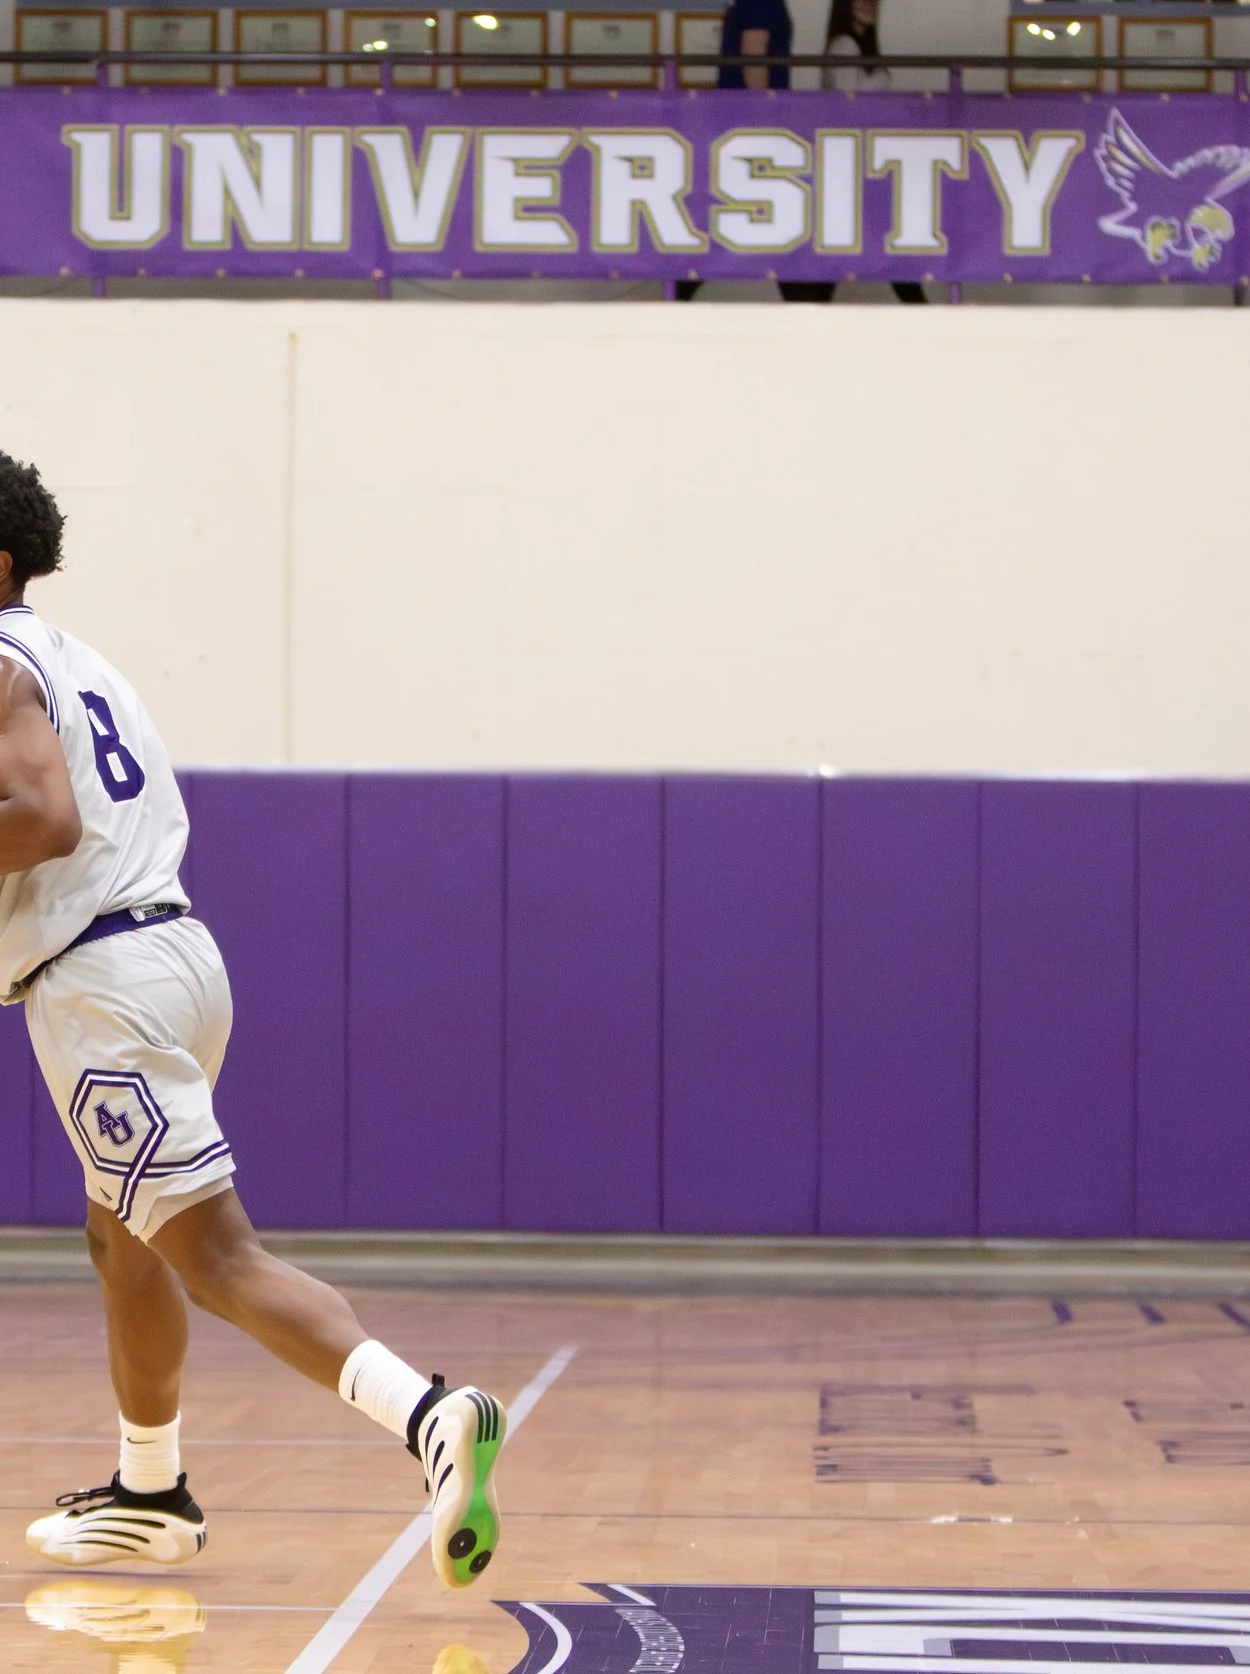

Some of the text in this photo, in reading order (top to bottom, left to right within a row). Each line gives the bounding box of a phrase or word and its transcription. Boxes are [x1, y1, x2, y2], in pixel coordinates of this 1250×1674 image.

[61, 124, 1085, 254] UNIVERSITY
[77, 690, 146, 803] 8
[93, 1101, 136, 1147] AU
